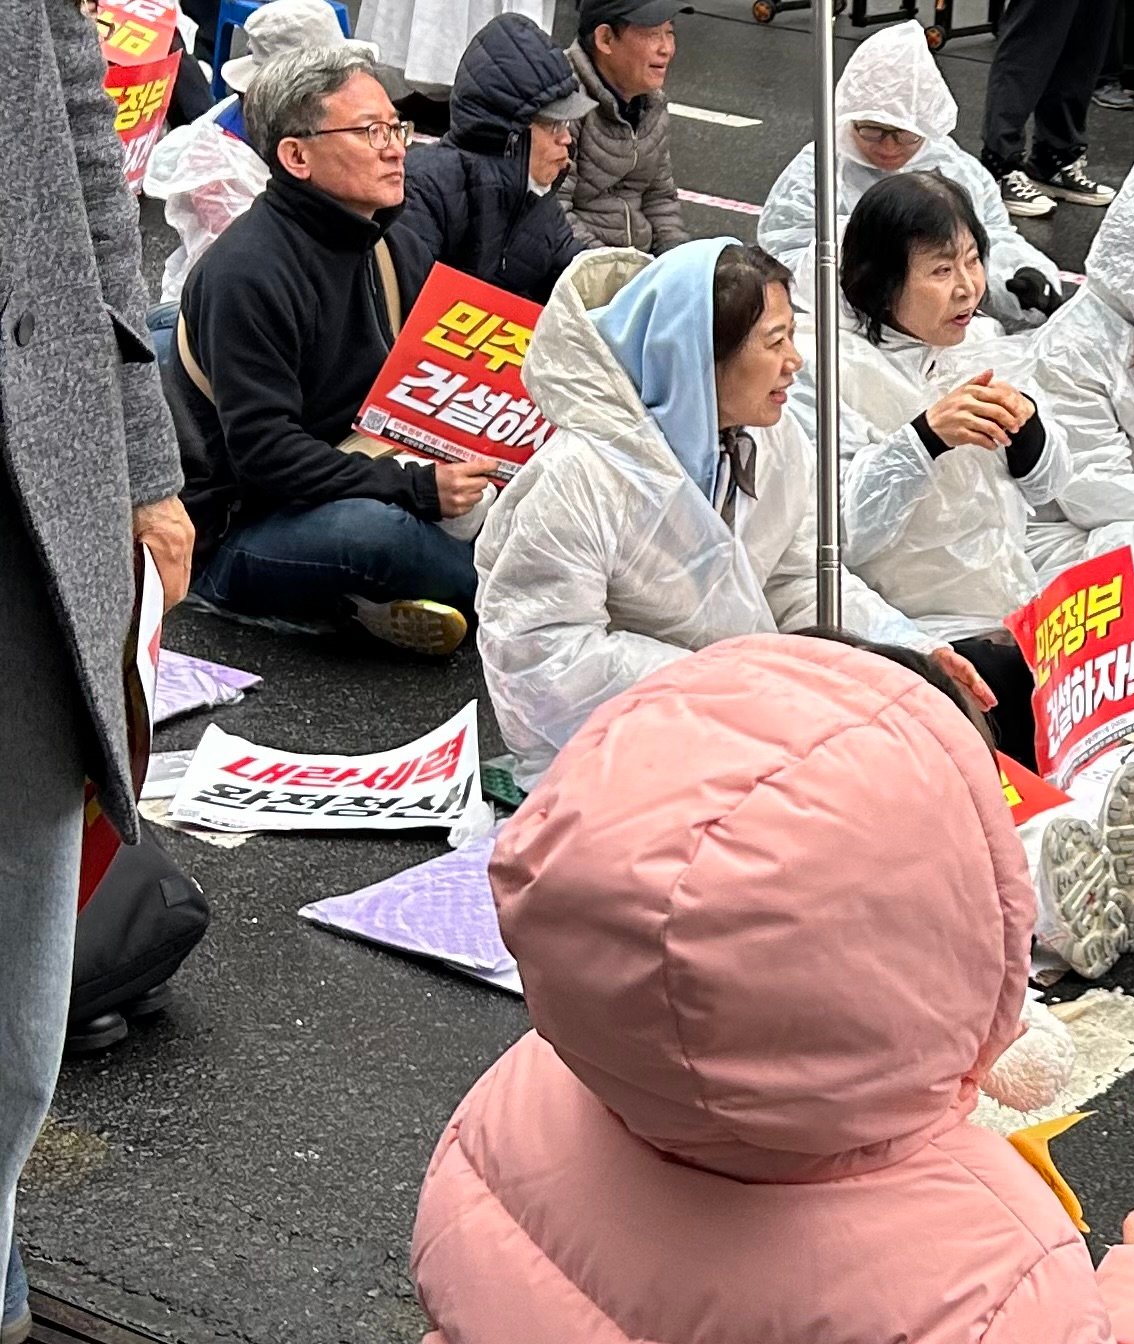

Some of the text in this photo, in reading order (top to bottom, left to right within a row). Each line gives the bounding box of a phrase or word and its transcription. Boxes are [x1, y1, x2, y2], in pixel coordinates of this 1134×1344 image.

[421, 300, 534, 372] 민주
[1035, 574, 1124, 690] 민주정부
[218, 724, 468, 792] 내란세력
